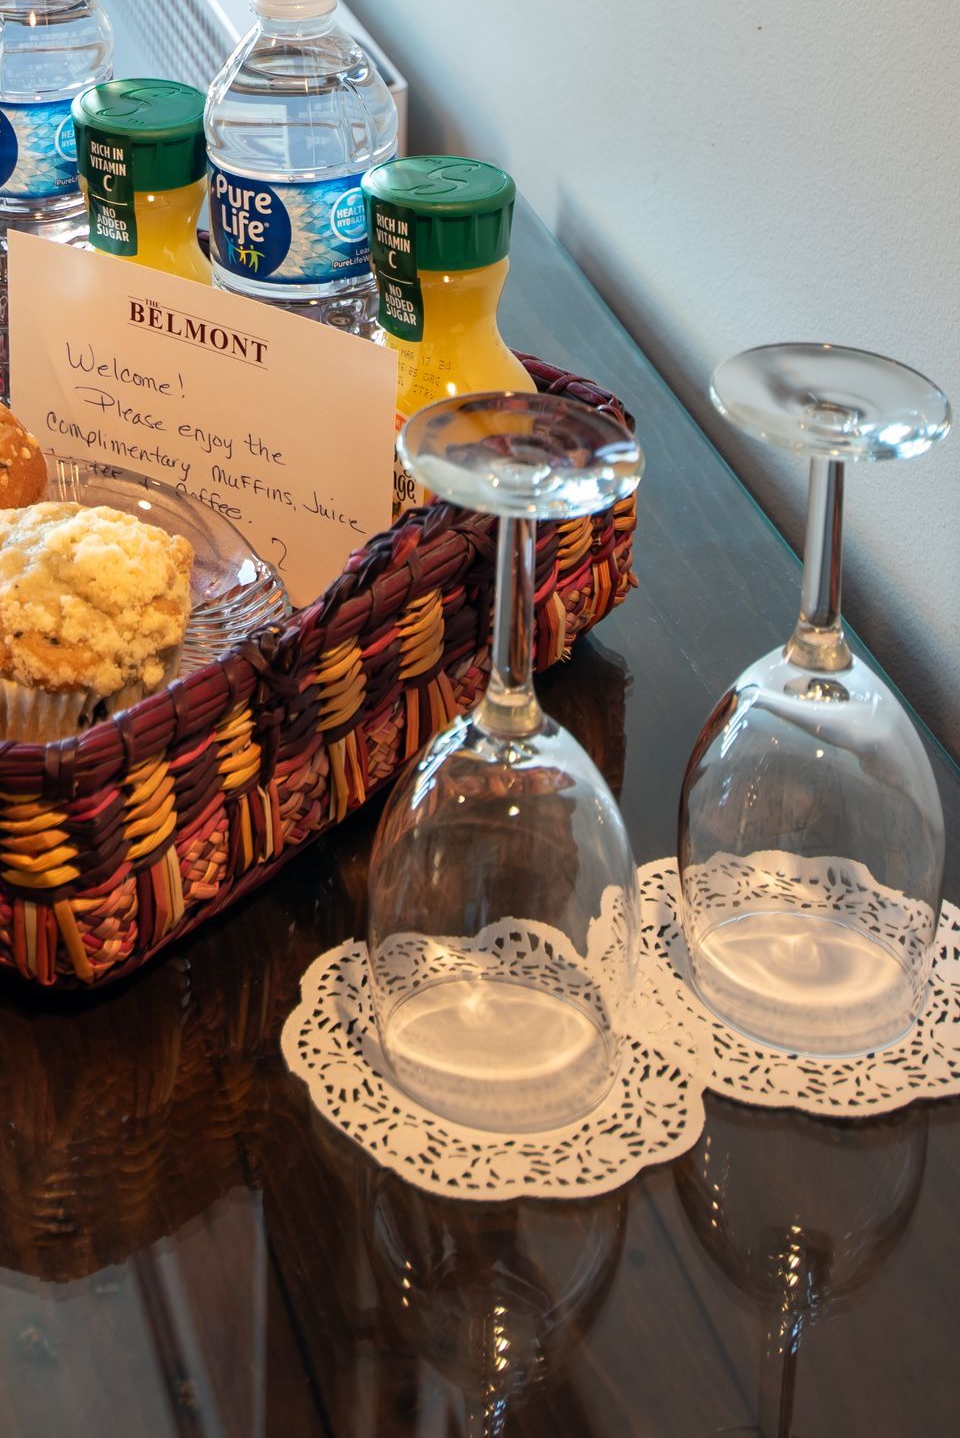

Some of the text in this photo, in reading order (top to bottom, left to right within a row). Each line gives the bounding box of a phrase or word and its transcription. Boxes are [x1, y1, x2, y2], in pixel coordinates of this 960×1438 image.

[91, 141, 124, 161] RICH IN
[90, 154, 127, 177] VITAMIN
[103, 174, 112, 192] C
[216, 173, 272, 215] Pure
[97, 213, 127, 231] ADDED
[102, 205, 116, 219] NO
[96, 223, 130, 243] SUGAR
[376, 212, 408, 237] RICH IN
[375, 227, 411, 254] VITAMIN
[388, 250, 397, 269] C
[388, 282, 402, 298] NO
[145, 298, 159, 308] THE
[385, 291, 414, 313] ADDED
[386, 303, 417, 326] SUGAR
[129, 301, 268, 364] BELMONT
[66, 341, 185, 399] Welcome!
[74, 386, 288, 466] Please enjoy the
[302, 490, 367, 534] Juice
